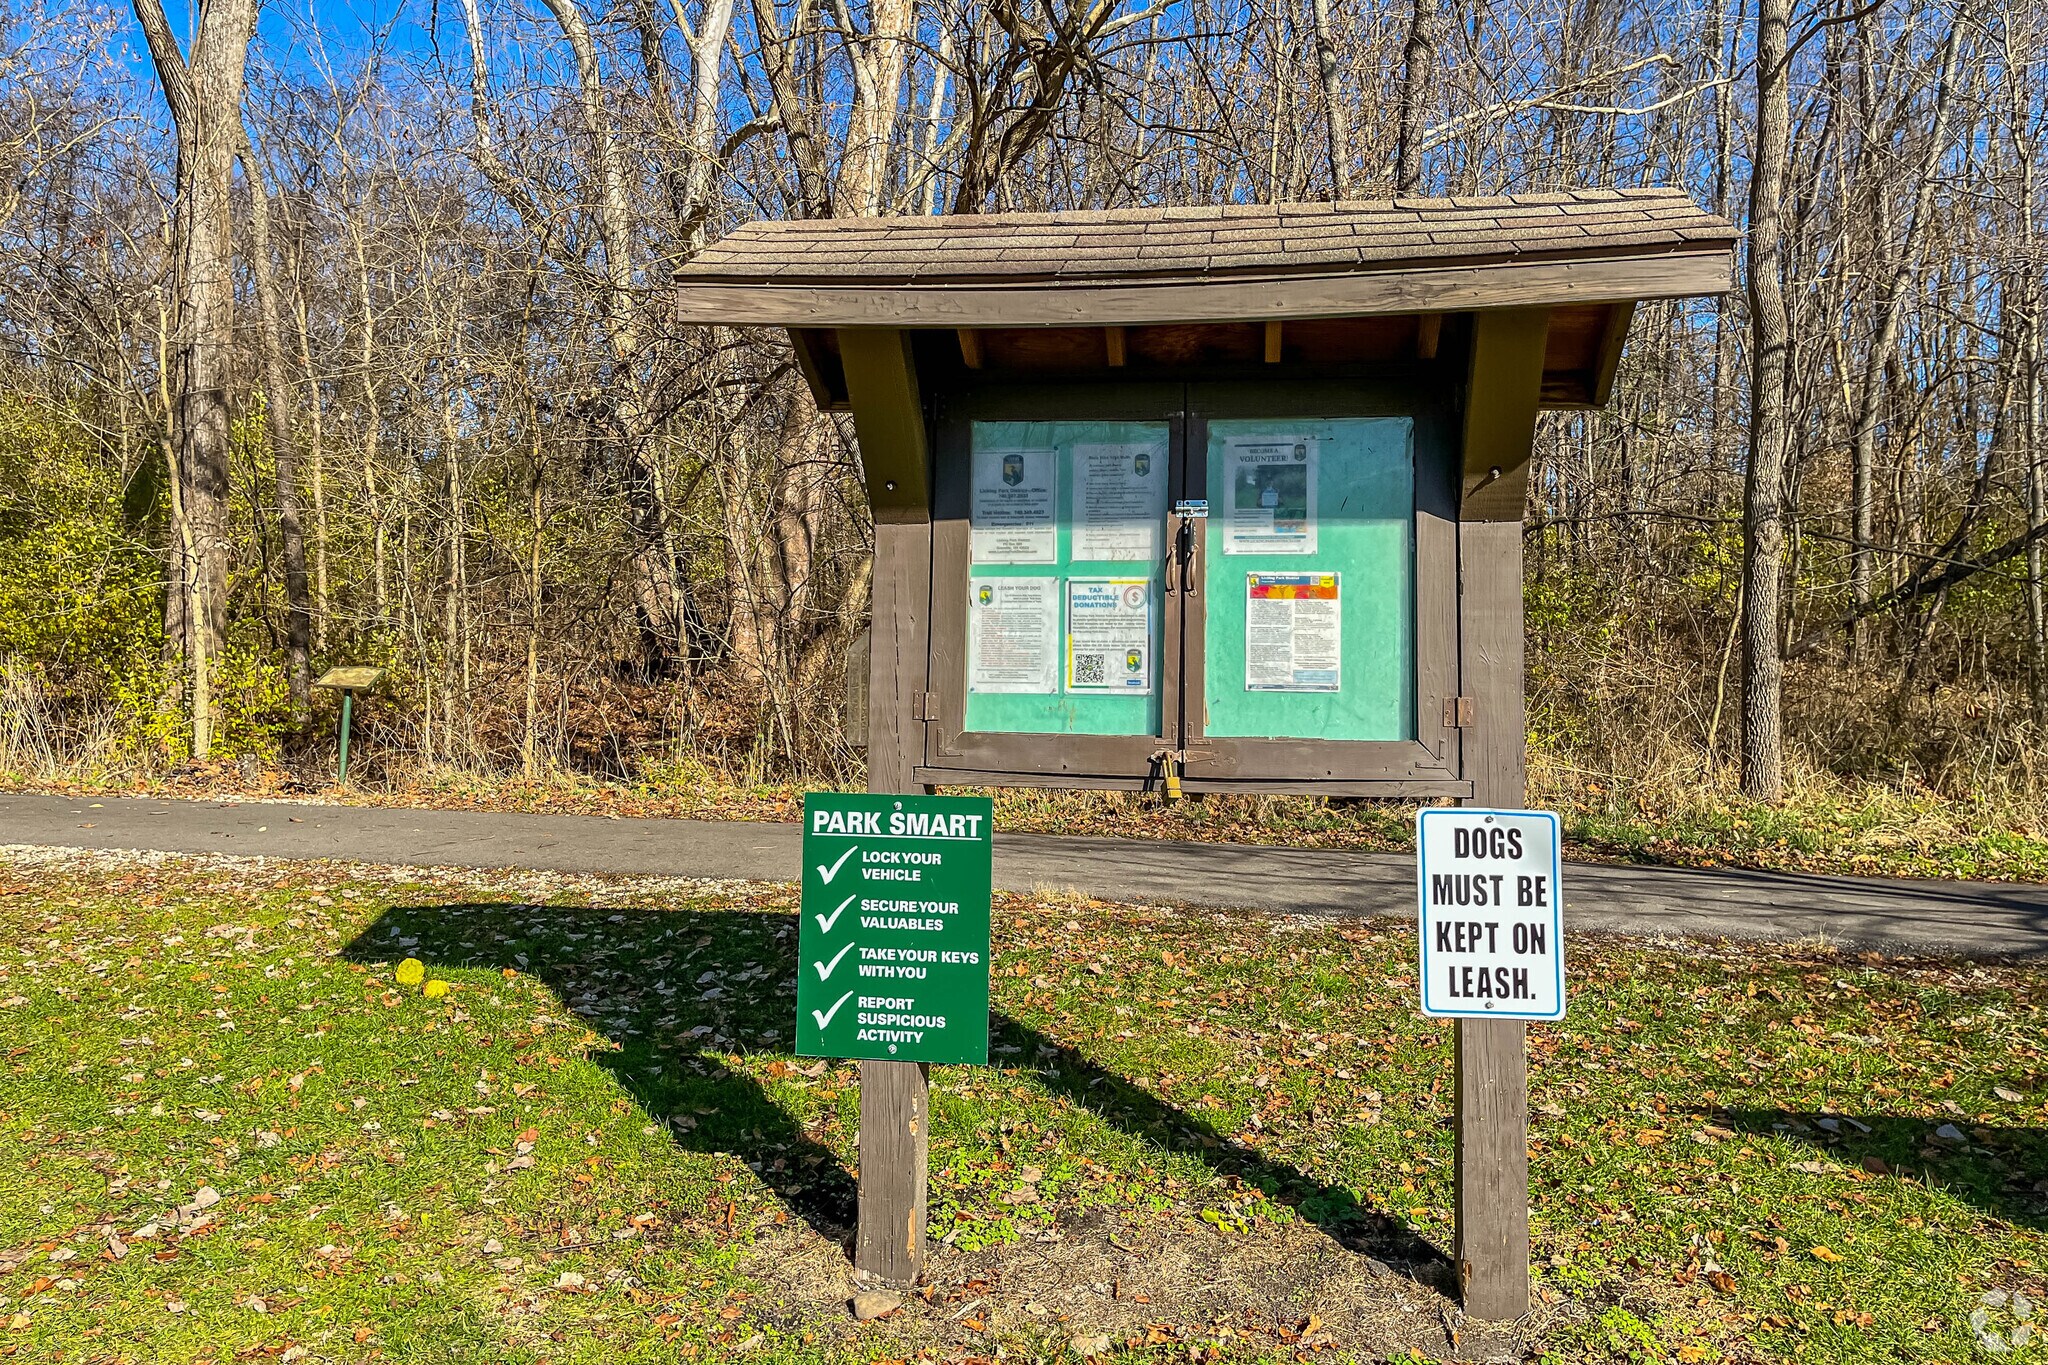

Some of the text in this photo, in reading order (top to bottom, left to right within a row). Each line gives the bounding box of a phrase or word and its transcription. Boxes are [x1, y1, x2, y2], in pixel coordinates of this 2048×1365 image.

[813, 810, 982, 837] PARK SMART
[1454, 827, 1523, 860] DOGS
[862, 851, 941, 865] LOCK YOUR
[861, 868, 921, 882] VEHICLE
[1432, 874, 1547, 907] MUST BE
[860, 899, 959, 915] SECURE YOUR
[860, 916, 943, 931] VALUABLES
[1436, 921, 1546, 955] KEPT ON
[859, 947, 979, 964] TAKE YOUR KEYS
[858, 964, 927, 980] WITH YOU
[1449, 965, 1536, 1000] LEASH.
[858, 996, 914, 1010] REPORT
[857, 1013, 946, 1028] SUSPICIOUS
[857, 1029, 923, 1044] ACTIVITY
